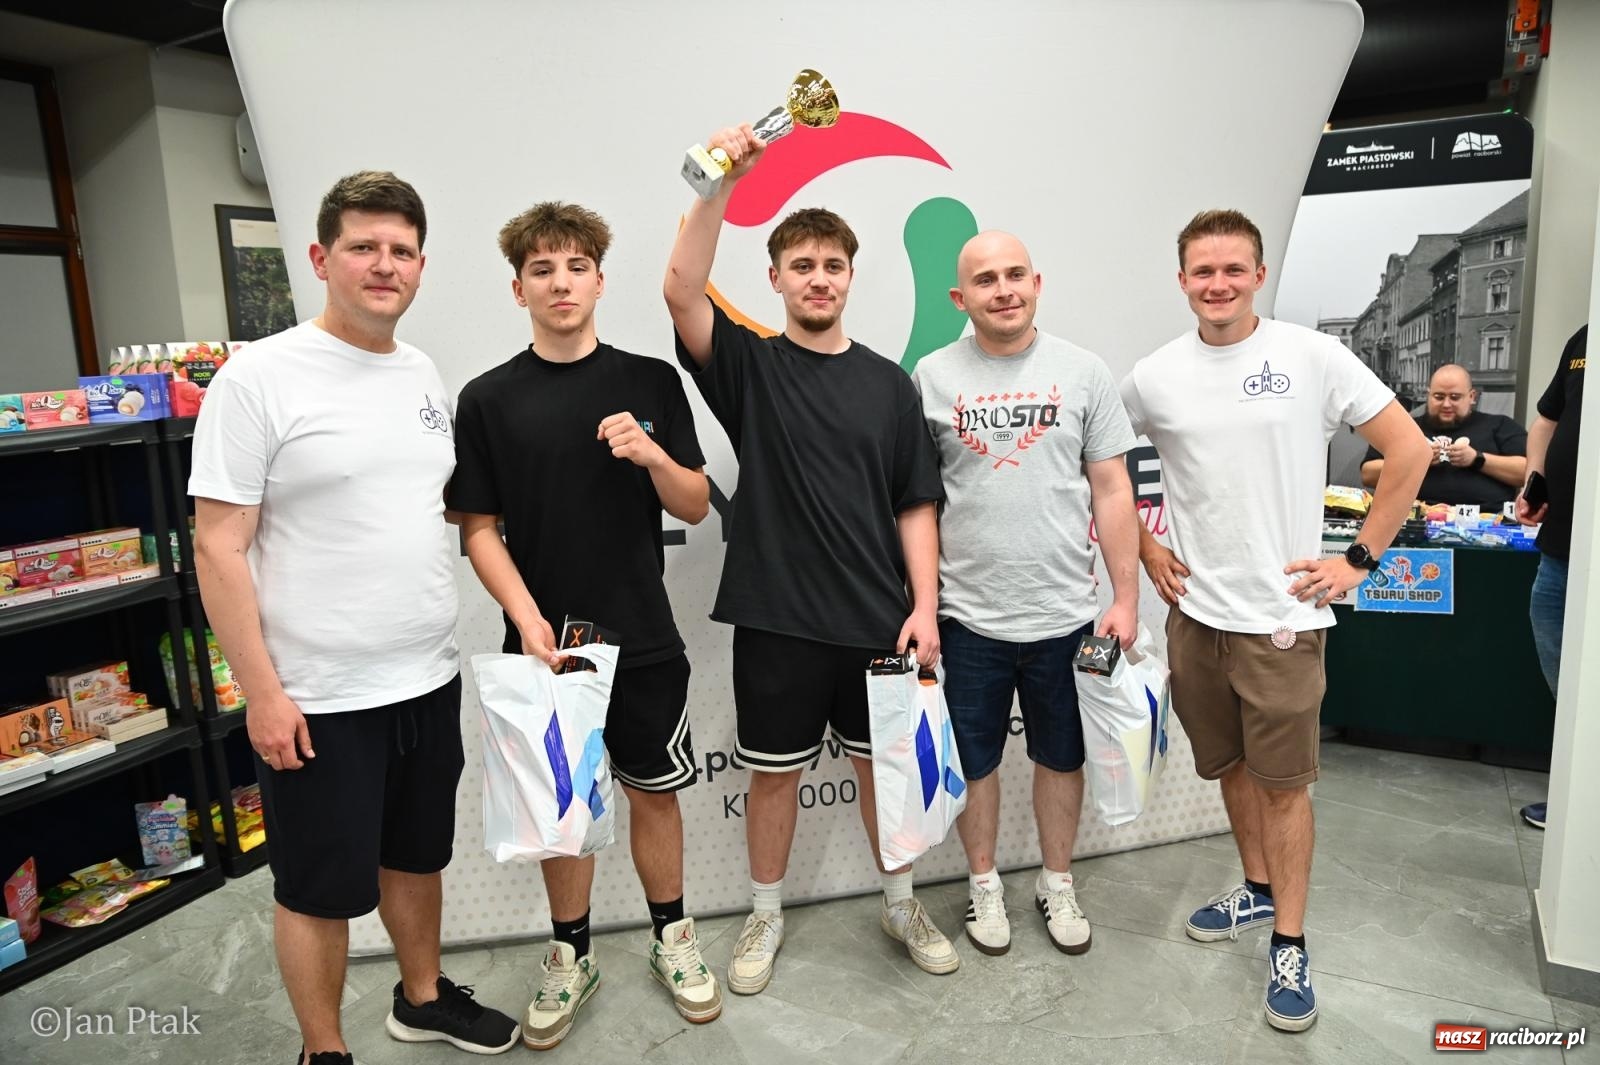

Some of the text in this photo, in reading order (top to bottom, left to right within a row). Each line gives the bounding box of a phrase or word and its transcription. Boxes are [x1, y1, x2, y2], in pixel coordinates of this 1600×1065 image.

[1327, 151, 1414, 167] ZAMEK PIASTOWSKI
[1459, 508, 1464, 516] 4
[1366, 589, 1442, 602] TSURU SHOP
